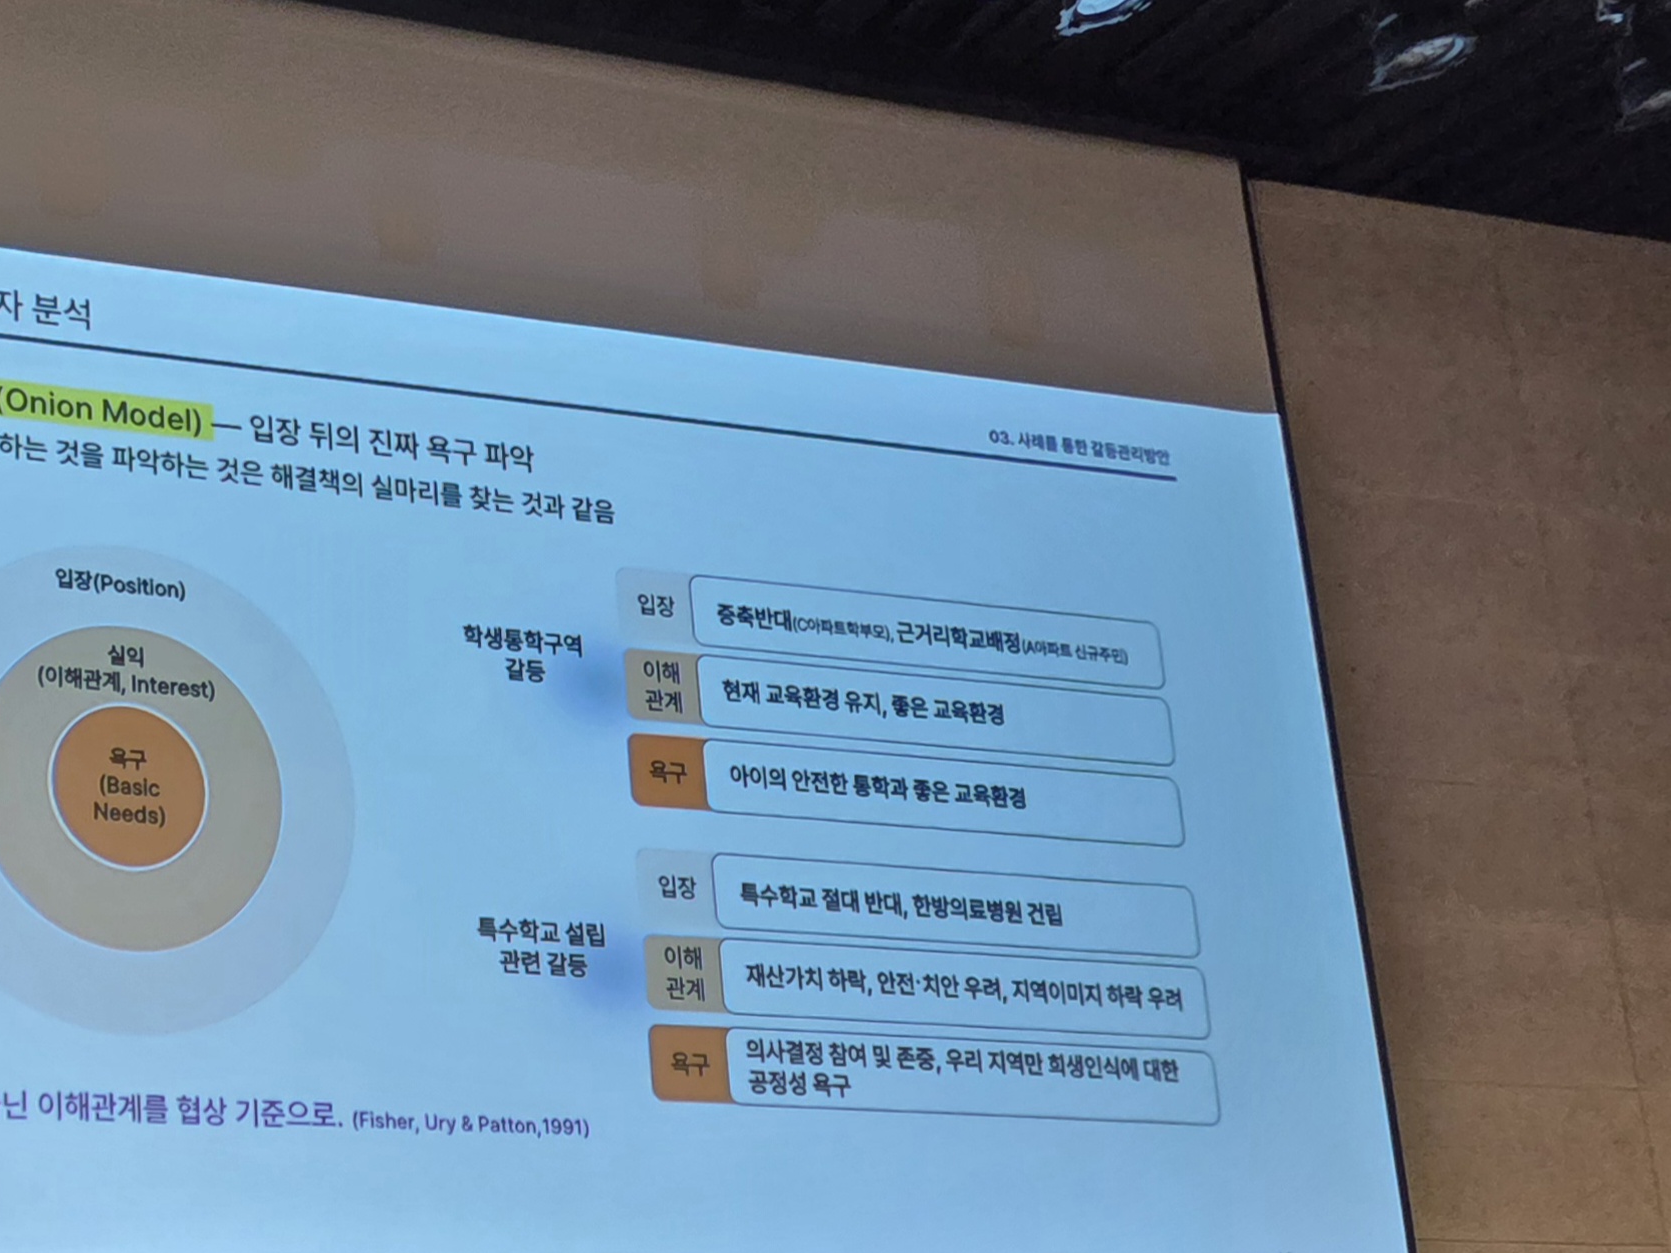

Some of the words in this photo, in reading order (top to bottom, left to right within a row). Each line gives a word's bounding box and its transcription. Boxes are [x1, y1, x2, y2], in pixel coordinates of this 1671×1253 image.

[31, 294, 91, 330] 분석
[103, 399, 202, 437] Model)
[249, 415, 300, 447] 입장
[309, 421, 359, 455] 뒤의
[368, 428, 420, 460] 진짜
[427, 436, 478, 466] 욕구
[485, 442, 534, 473] 파악
[989, 429, 1014, 445] 03.
[1019, 432, 1058, 452] 사례를
[1062, 437, 1088, 456] 통한
[56, 440, 103, 469] 것을
[112, 446, 209, 479] 파악하는
[216, 458, 263, 485] 것은
[271, 463, 364, 497] 해결책의
[371, 475, 462, 508] 실마리를
[470, 486, 514, 514] 찾는
[522, 492, 564, 520] 것과
[572, 497, 616, 524] 같음
[55, 569, 186, 601] 입장(Position)
[638, 593, 674, 618] 입장
[463, 623, 583, 658] 학생통학구역
[108, 645, 144, 668] 실익
[505, 657, 545, 683] 갈등
[37, 665, 126, 695] (이해관계,
[131, 675, 215, 701] Interest)
[644, 660, 680, 684] 이해
[646, 689, 683, 714] 관계
[722, 679, 760, 704] 현재
[766, 685, 840, 711] 교육환경
[844, 693, 887, 719] 유지,
[891, 697, 928, 719] 좋은
[934, 700, 1005, 726] 교육환경
[110, 747, 147, 770] 욕구
[649, 760, 688, 785] 욕구
[100, 774, 160, 797] (Basic
[730, 765, 787, 791] 아이의
[792, 770, 848, 795] 안전한
[853, 774, 908, 800] 통학과
[913, 779, 950, 802] 좋은
[955, 783, 1027, 810] 교육환경
[93, 802, 166, 828] Needs)
[658, 874, 697, 900] 입장
[740, 882, 818, 909] 특수학교
[821, 888, 860, 913] 절대
[865, 890, 908, 920] 반대,
[912, 894, 1023, 924] 한방의료병원
[1027, 902, 1064, 927] 건립
[477, 916, 561, 944] 특수학교
[565, 922, 606, 948] 설립
[500, 949, 541, 976] 관련
[547, 952, 588, 978] 갈등
[664, 945, 703, 970] 이해
[666, 977, 705, 1002] 관계
[746, 963, 823, 991] 재산가치
[828, 968, 872, 996] 하락,
[964, 976, 1007, 1004] 우려,
[1011, 979, 1103, 1007] 지역이미지
[1106, 984, 1143, 1009] 하락
[1148, 986, 1184, 1012] 우려
[671, 1052, 710, 1077] 욕구
[746, 1038, 823, 1066] 의사결정
[829, 1042, 867, 1068] 참여
[872, 1044, 892, 1069] 및
[896, 1046, 941, 1076] 존중,
[946, 1048, 983, 1073] 우리
[988, 1050, 1044, 1076] 지역만
[1048, 1052, 1140, 1082] 희생인식에
[1143, 1057, 1179, 1083] 대한
[748, 1070, 807, 1096] 공정성
[813, 1072, 851, 1098] 욕구
[38, 1091, 168, 1125] 이해관계를
[177, 1095, 227, 1127] 협상
[236, 1098, 344, 1129] 기준으로.
[353, 1110, 420, 1135] (Fisher,
[424, 1113, 456, 1136] Ury
[461, 1116, 474, 1131] &
[478, 1115, 590, 1139] Patton,1991)
